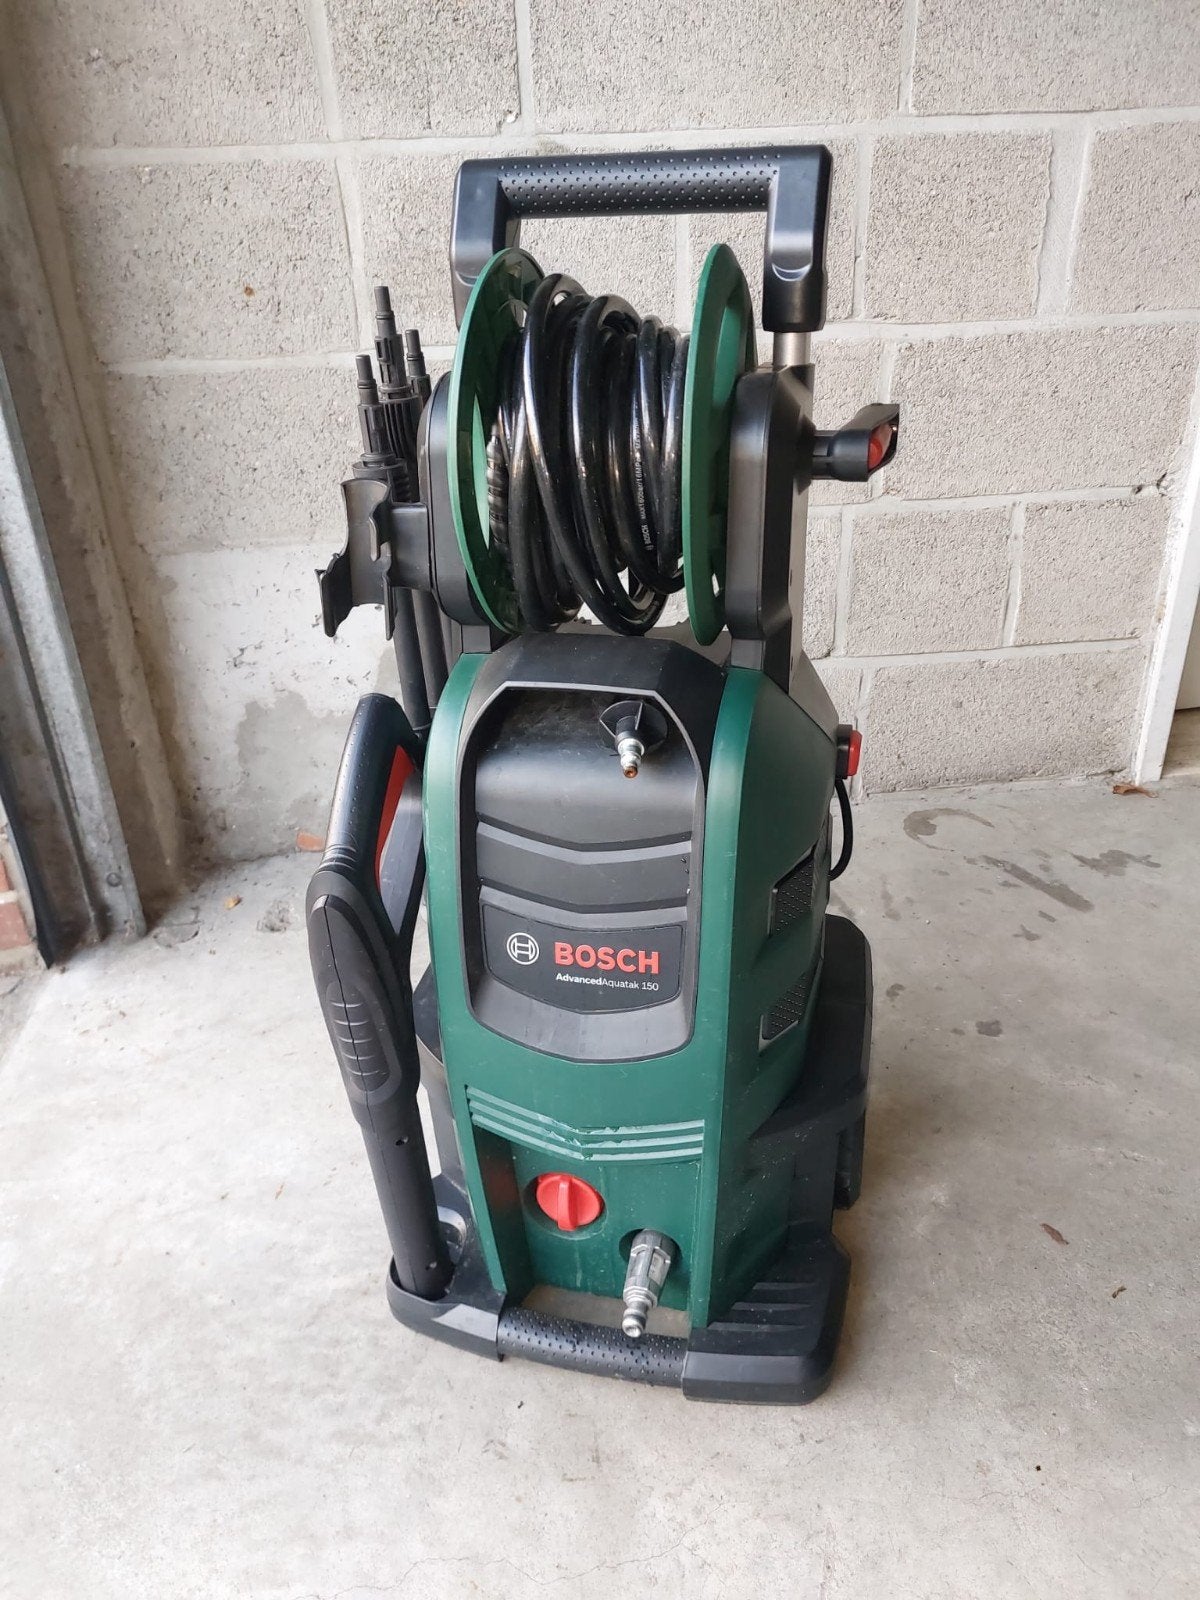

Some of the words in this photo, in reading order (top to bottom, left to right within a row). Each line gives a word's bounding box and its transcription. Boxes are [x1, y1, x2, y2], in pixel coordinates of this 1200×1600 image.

[641, 524, 651, 545] BOSCH
[554, 941, 661, 975] BOSCH
[555, 972, 640, 990] AdvancedAquatak
[641, 981, 660, 992] 150
